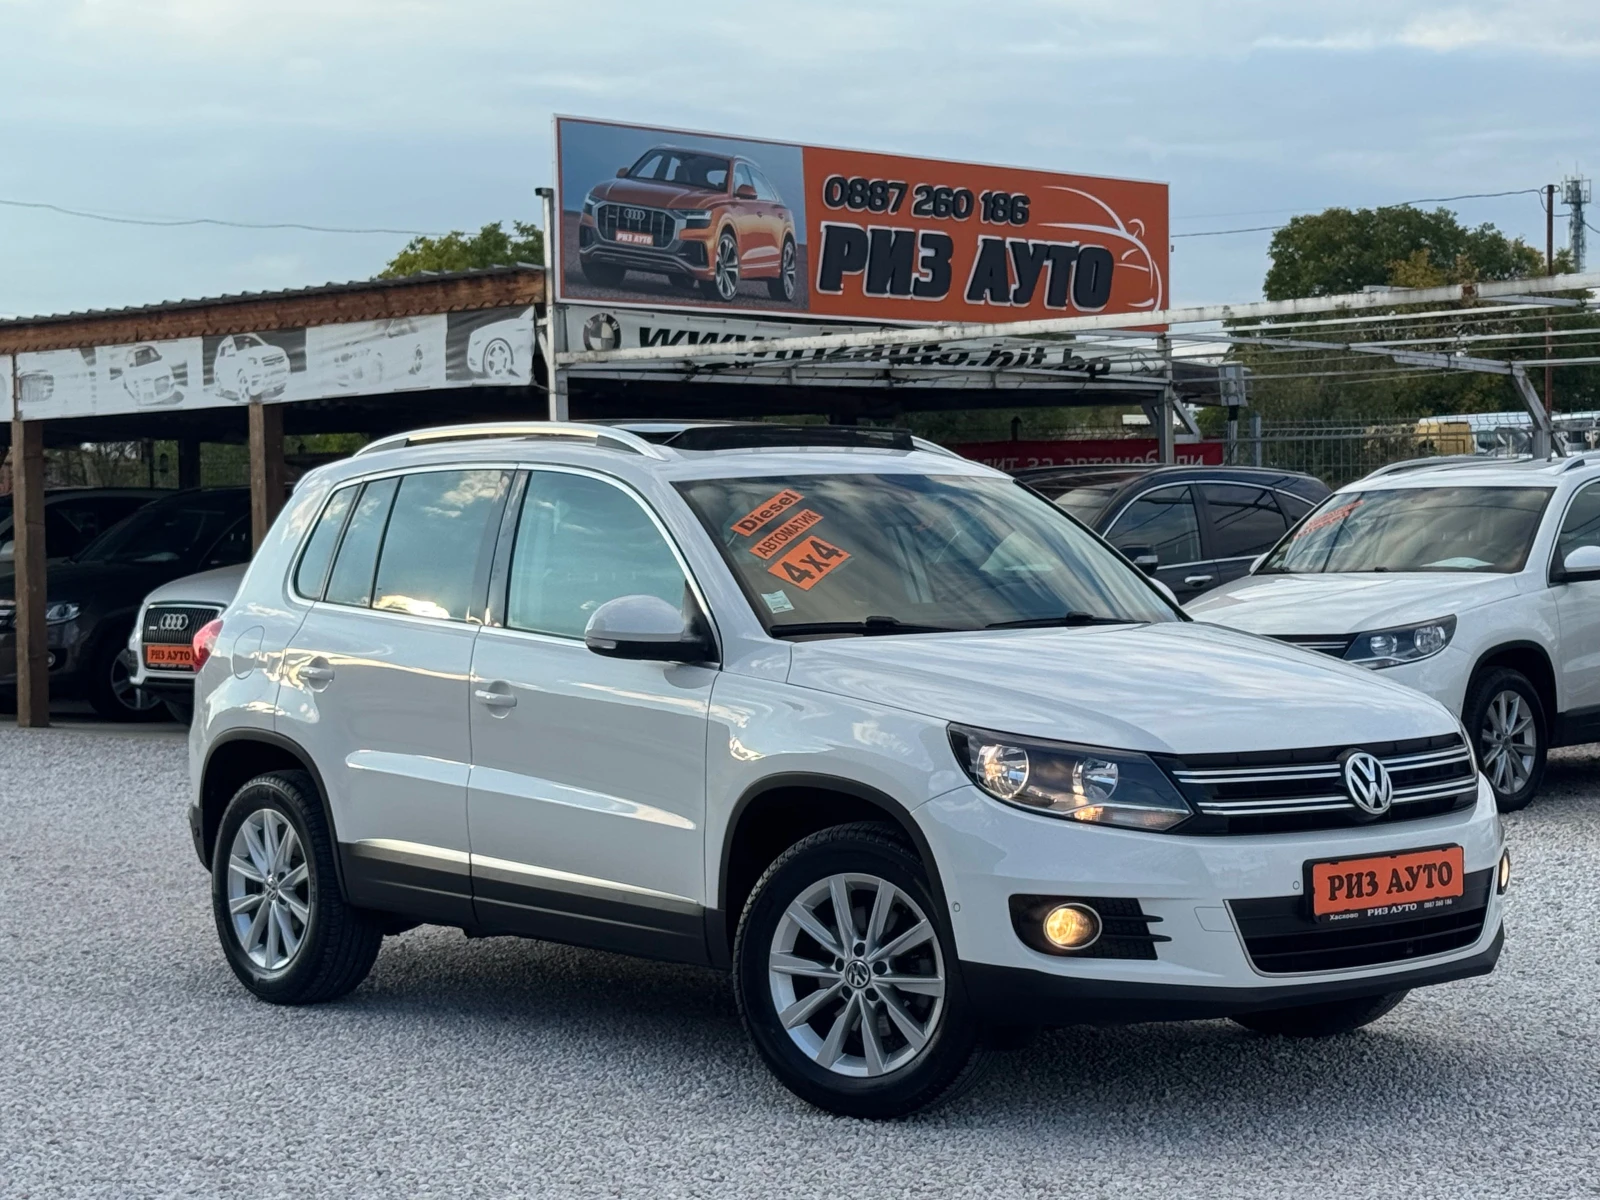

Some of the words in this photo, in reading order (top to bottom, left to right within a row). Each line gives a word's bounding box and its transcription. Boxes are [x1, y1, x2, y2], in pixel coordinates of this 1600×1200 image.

[823, 174, 908, 215] 0887
[912, 183, 974, 220] 260
[979, 189, 1030, 226] 186
[816, 221, 954, 302] РИЗ
[964, 235, 1114, 312] АУТО
[1063, 449, 1204, 466] автомобли
[738, 492, 798, 532] Diesel
[757, 511, 819, 556] АВТОМАТИК
[168, 651, 190, 660] АУТО
[1327, 871, 1379, 901] РИЗ
[1386, 861, 1453, 894] АУТО
[1367, 907, 1388, 917] РИЗ
[1390, 903, 1418, 914] АУТО
